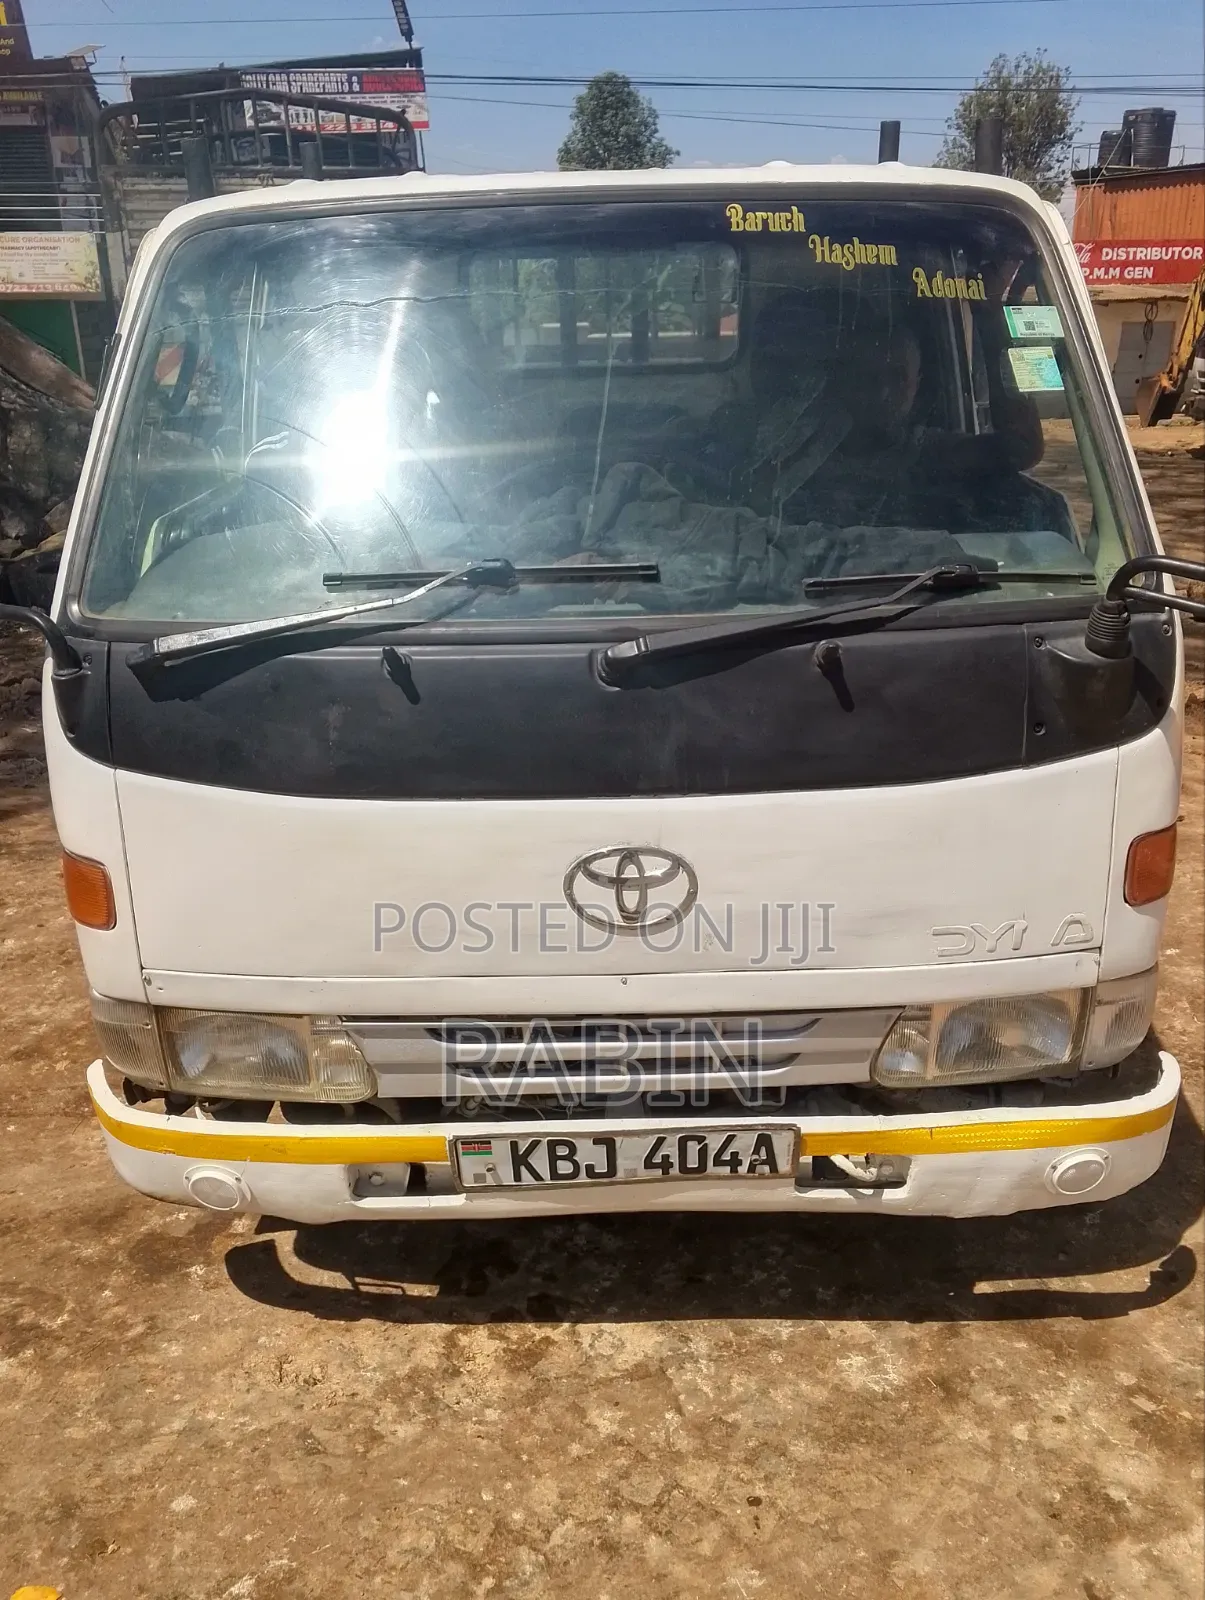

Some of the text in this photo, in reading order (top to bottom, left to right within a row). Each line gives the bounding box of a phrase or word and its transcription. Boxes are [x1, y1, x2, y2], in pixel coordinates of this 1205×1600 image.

[268, 73, 289, 92] CAR
[352, 76, 360, 92] &
[726, 203, 806, 232] Baruch
[808, 234, 898, 271] Hashem
[1101, 247, 1203, 260] DISTRIBUTOR
[912, 267, 987, 300] Adonai
[1124, 267, 1153, 279] GEN
[509, 1132, 780, 1183] KBJ 404A
